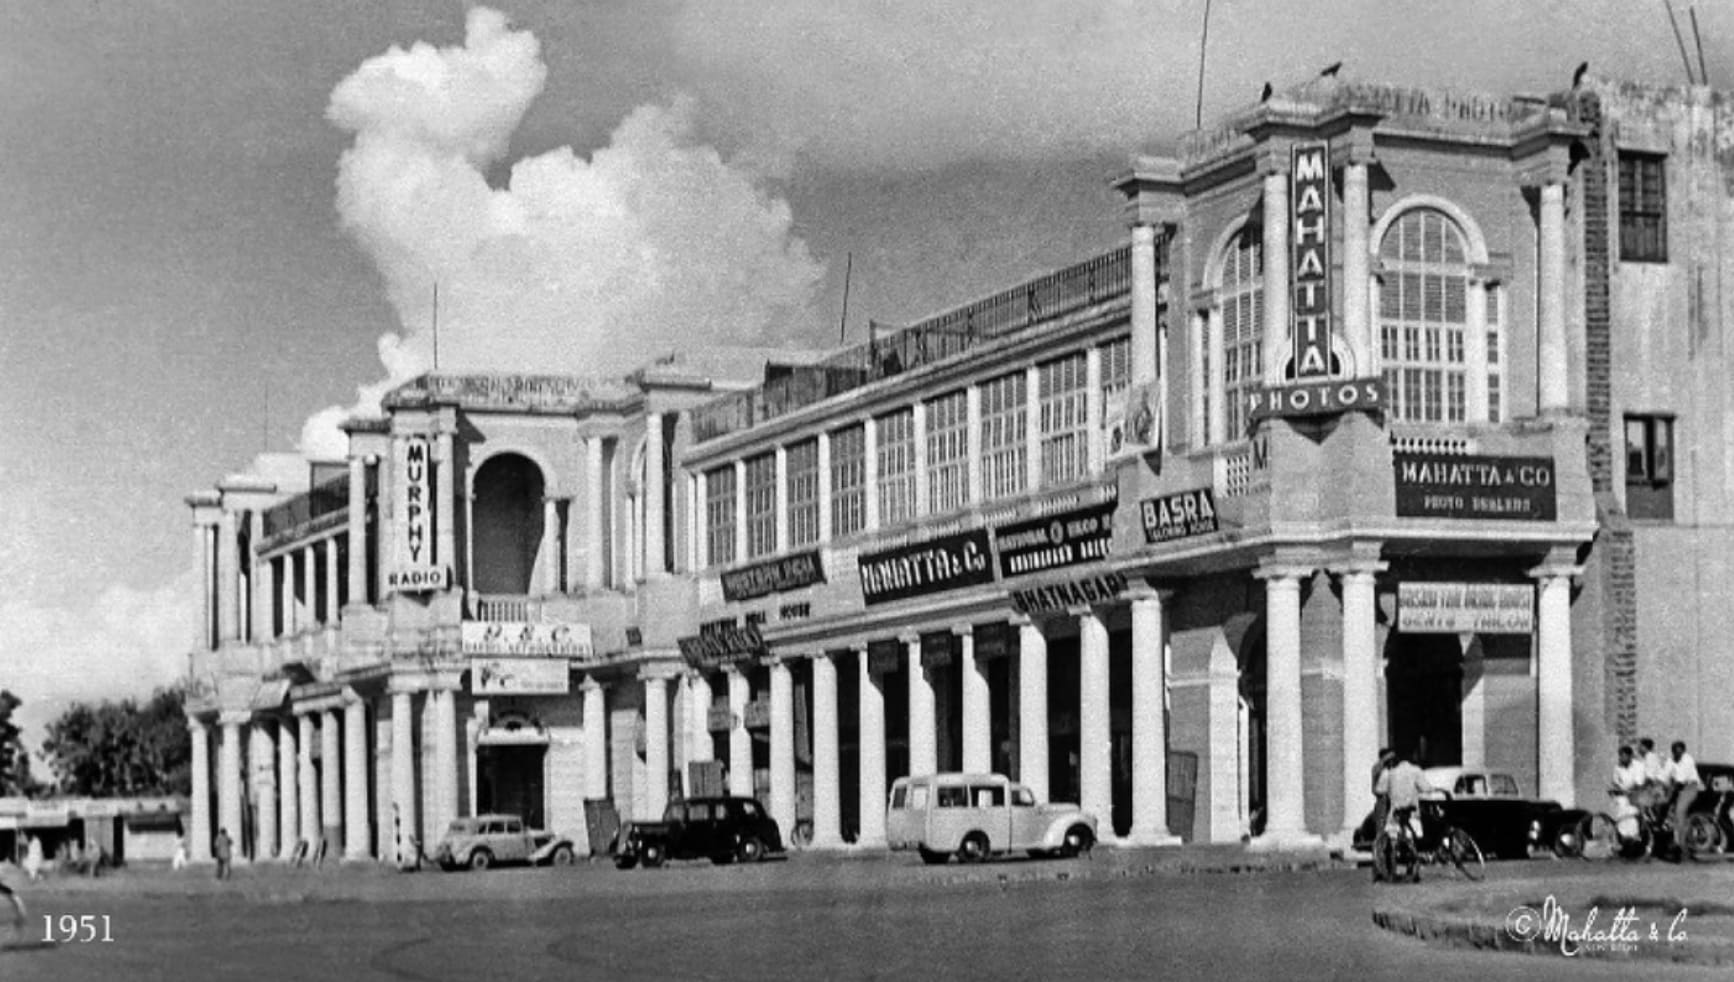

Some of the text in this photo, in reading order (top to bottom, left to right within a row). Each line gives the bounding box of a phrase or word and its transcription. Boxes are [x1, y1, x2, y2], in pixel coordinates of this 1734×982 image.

[1296, 151, 1326, 374] MAHATTA
[1249, 383, 1379, 411] PHOTOS
[1402, 460, 1501, 486] MAHATTA
[406, 445, 424, 562] MURPHY
[1143, 489, 1214, 529] BASRA
[1423, 495, 1464, 510] PHOTO
[389, 571, 441, 586] RADIO
[862, 547, 952, 595] MAHATTA
